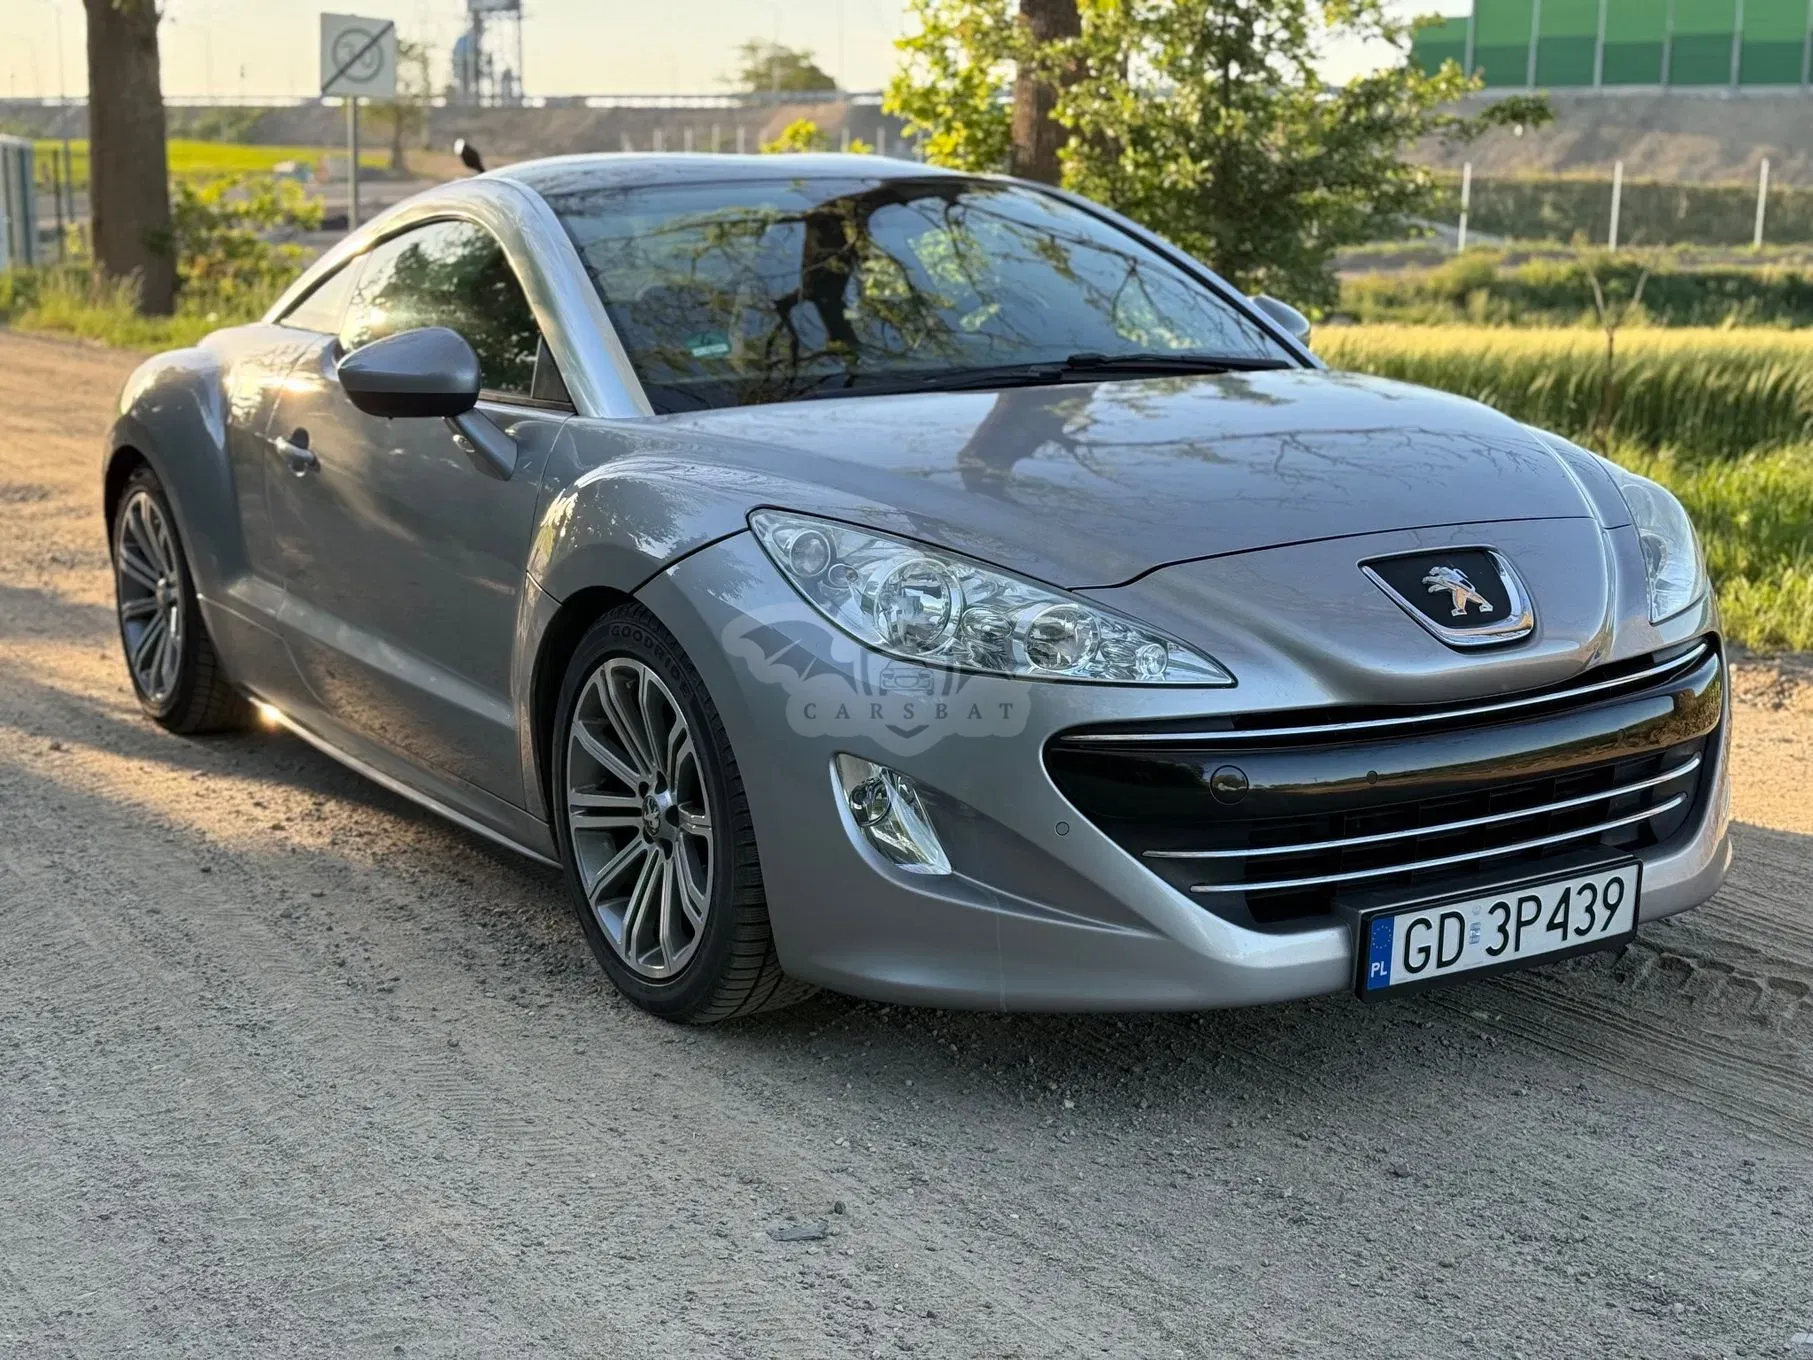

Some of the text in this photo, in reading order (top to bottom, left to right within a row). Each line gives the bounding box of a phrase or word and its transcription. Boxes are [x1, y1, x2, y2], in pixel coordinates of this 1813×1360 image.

[1403, 876, 1625, 974] GD 3P439
[1370, 961, 1388, 978] PL
